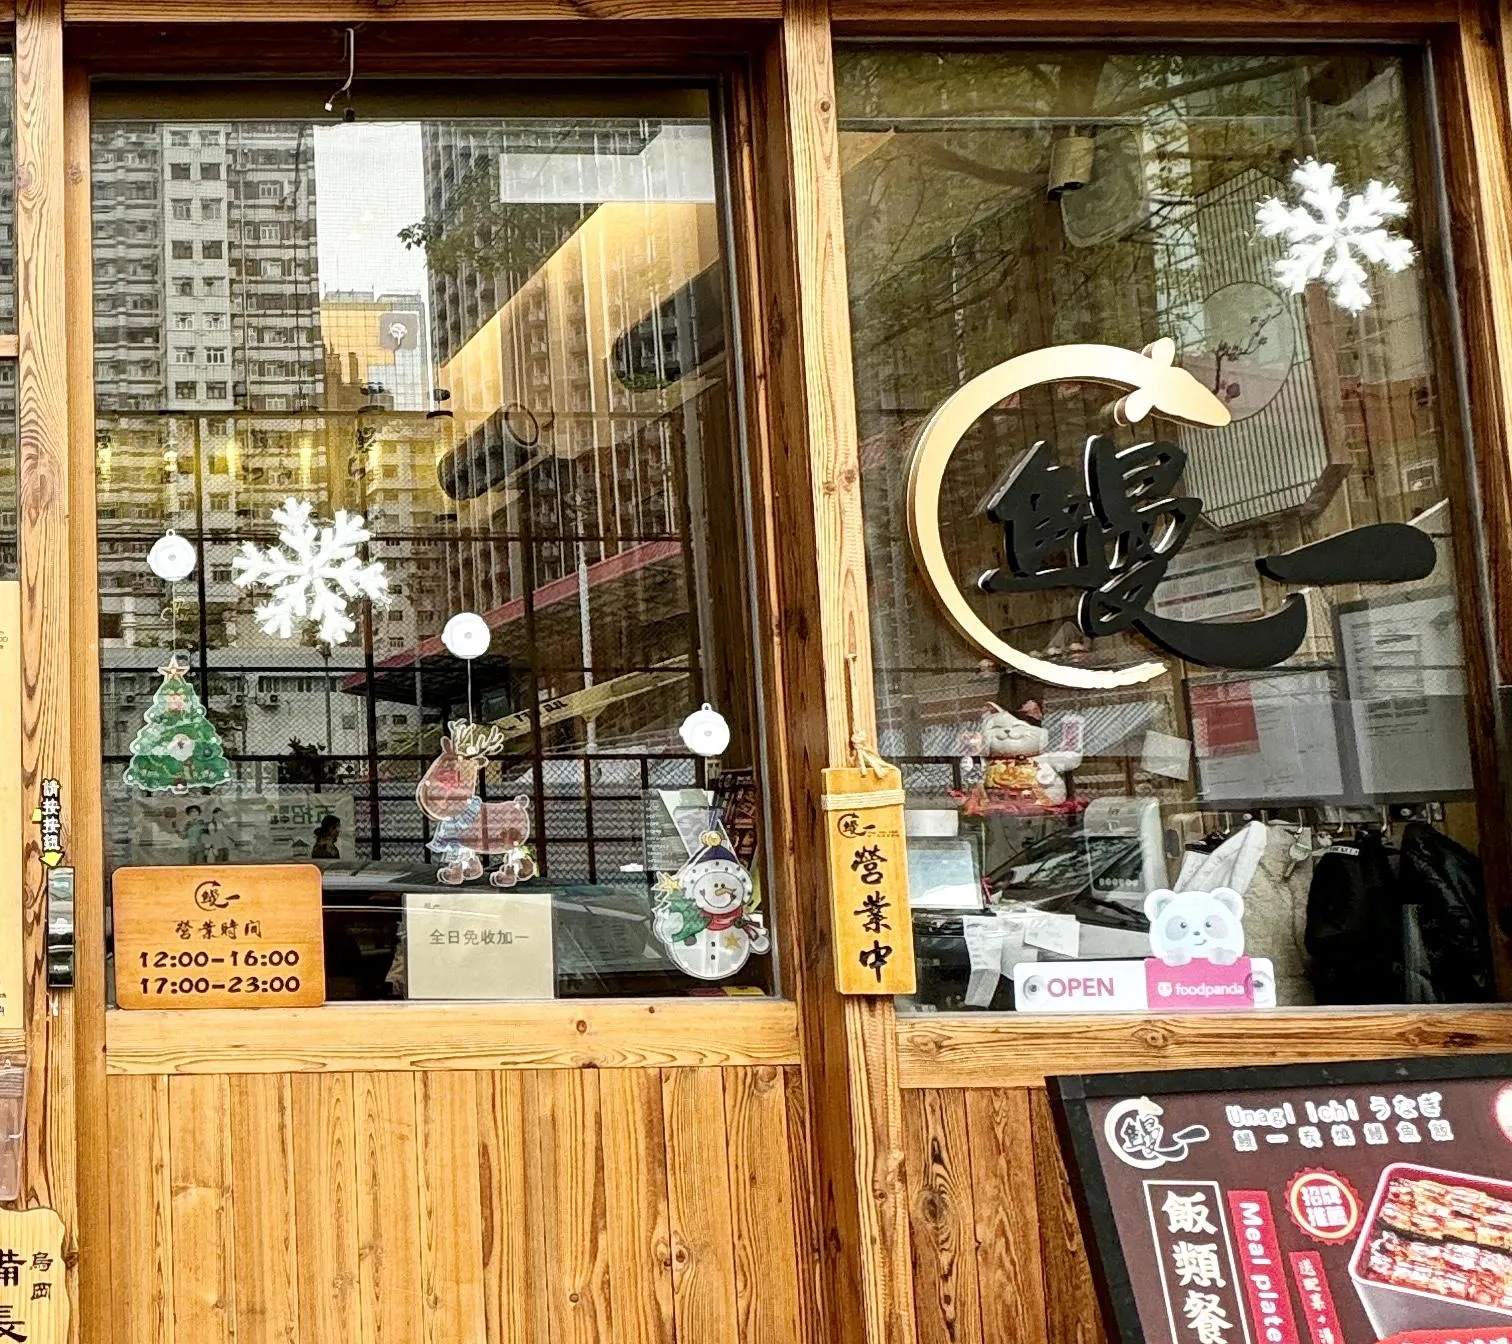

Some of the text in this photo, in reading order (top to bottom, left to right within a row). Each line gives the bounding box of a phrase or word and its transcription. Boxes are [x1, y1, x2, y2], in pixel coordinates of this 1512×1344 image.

[851, 845, 893, 983] 營業中
[429, 928, 530, 946] 全日免收加一
[139, 949, 300, 968] 12:00-16:00
[140, 976, 301, 994] 17:00-23:00
[1047, 976, 1115, 998] OPEN
[1175, 981, 1245, 999] foodpanda
[1238, 1202, 1272, 1267] Meal
